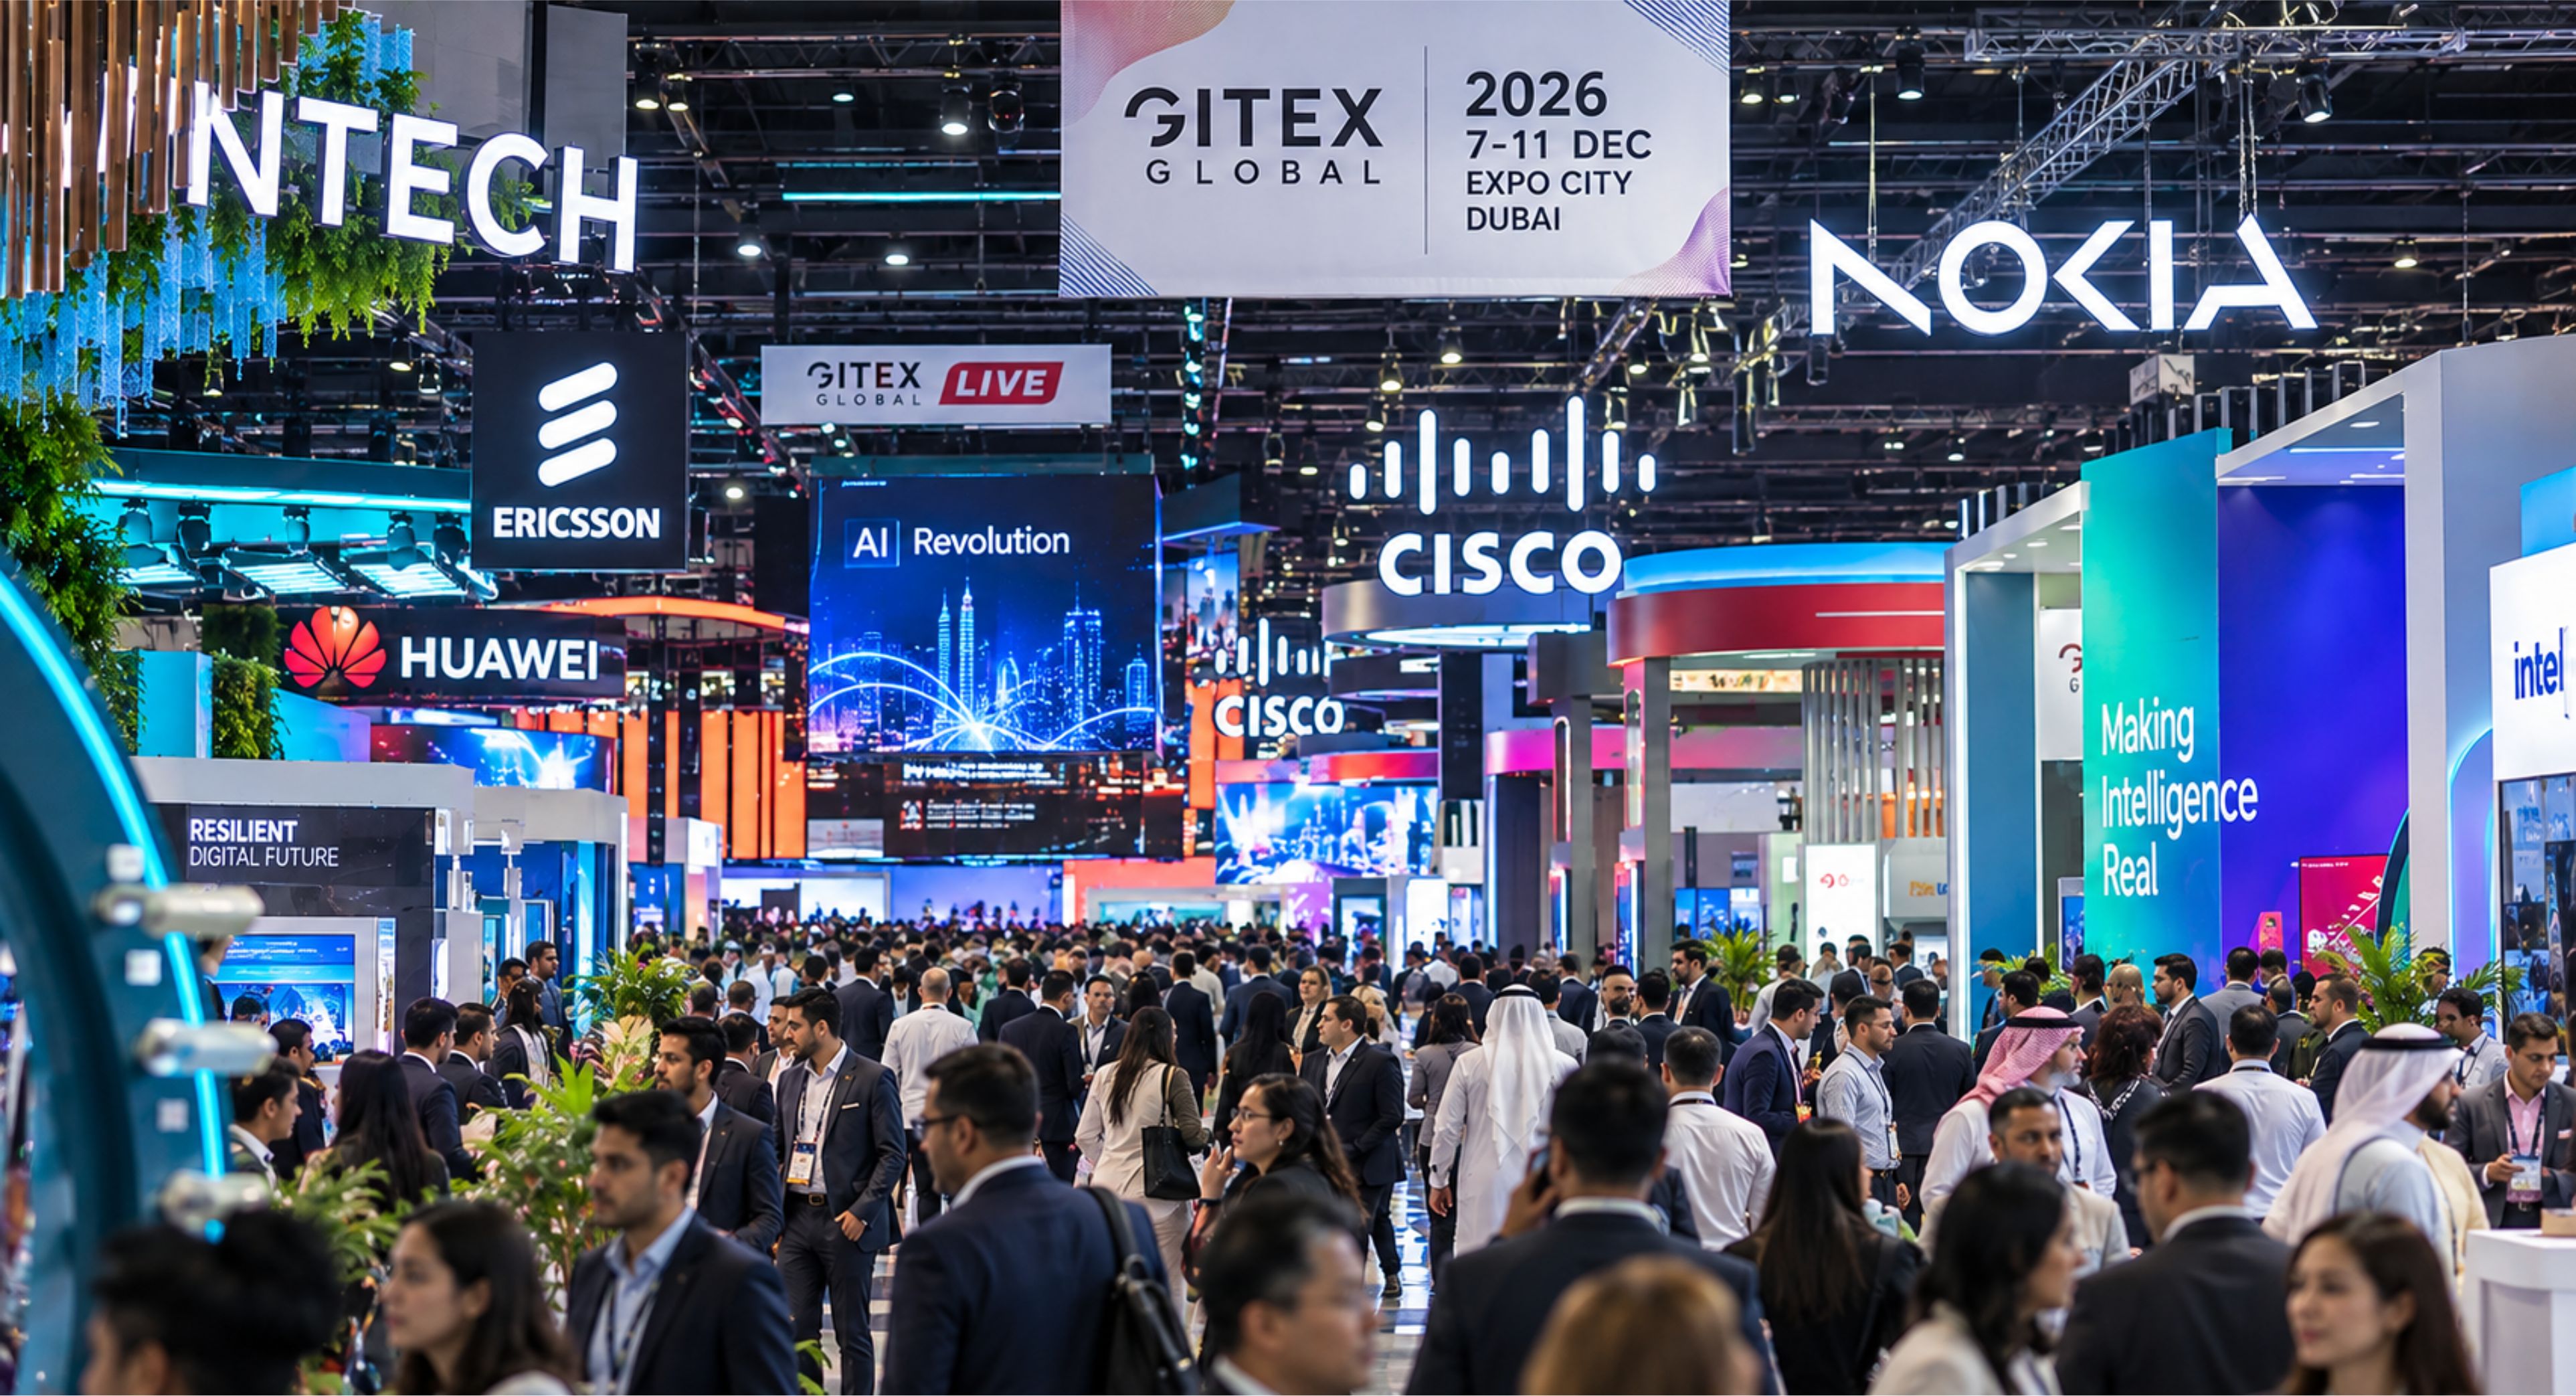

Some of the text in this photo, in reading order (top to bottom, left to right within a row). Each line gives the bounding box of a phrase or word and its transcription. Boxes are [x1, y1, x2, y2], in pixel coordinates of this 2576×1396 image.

[1466, 70, 1607, 117] 2026
[1124, 87, 1383, 148] GITEX
[1466, 129, 1651, 159] 7-11 DEC
[62, 67, 639, 273] NTECH
[1146, 159, 1380, 185] GLOBAL
[1467, 171, 1633, 195] EXPO CITY
[1467, 206, 1560, 231] DUBAI
[1811, 212, 2318, 337] NOKIA
[806, 361, 921, 389] GITEX
[955, 369, 1047, 396] LIVE
[816, 394, 921, 406] GLOBAL
[493, 507, 660, 538] ERICSSON
[852, 525, 1070, 558] AI Revolution
[1378, 530, 1623, 596] CISCO
[401, 636, 597, 681] HUAWEI
[2514, 627, 2564, 700] intel
[1215, 695, 1344, 737] CISCO
[2102, 697, 2195, 763] Making
[2102, 770, 2259, 841] Intelligence
[190, 818, 298, 843] RESILIENT
[190, 846, 339, 867] DIGITAL FUTURE
[2103, 841, 2158, 897] Real
